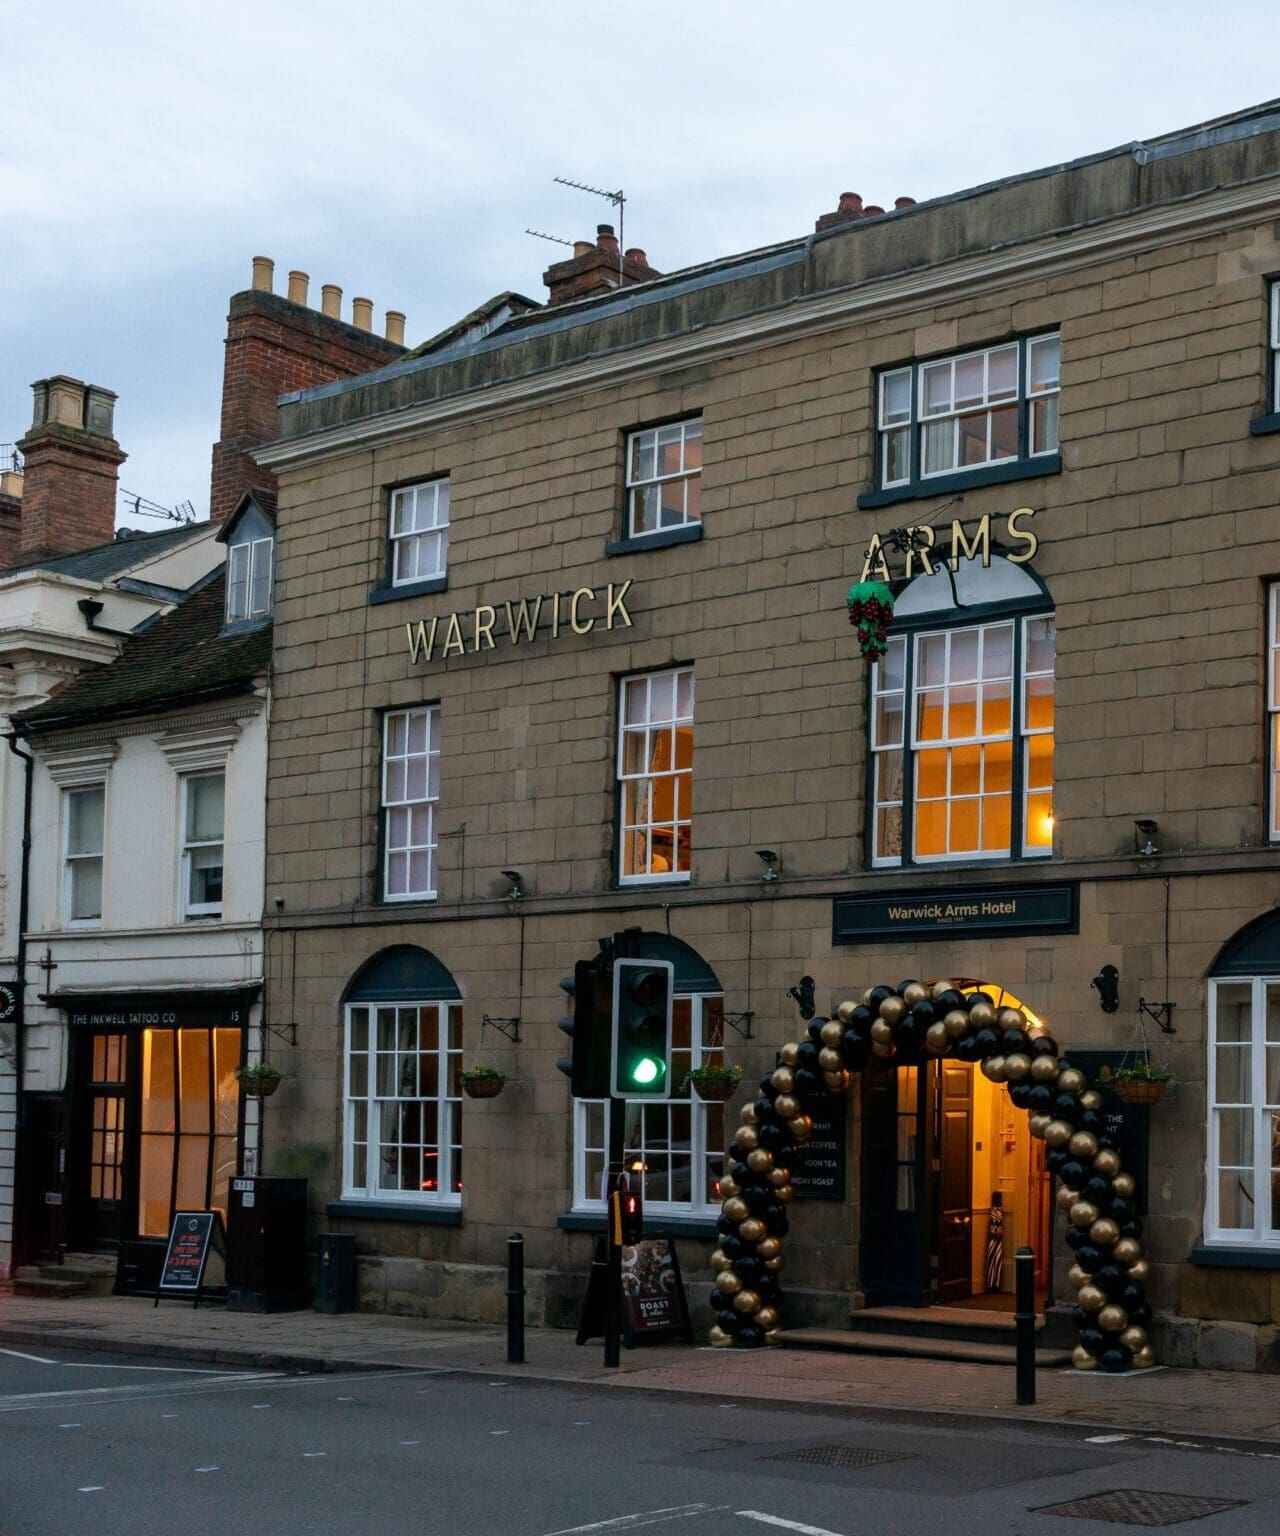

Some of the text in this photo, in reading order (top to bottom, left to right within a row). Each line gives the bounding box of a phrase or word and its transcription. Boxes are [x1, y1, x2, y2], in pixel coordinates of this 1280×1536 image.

[859, 506, 1041, 584] ARMS
[405, 578, 634, 666] WARWICK
[888, 904, 942, 920] Warwick
[945, 903, 979, 917] Arms
[981, 900, 1016, 915] Hotel
[72, 1014, 88, 1024] THE
[90, 1014, 126, 1024] INKWELL
[128, 1012, 159, 1024] TATTOO
[231, 1010, 240, 1022] 15
[824, 1159, 837, 1168] TEA
[812, 1177, 834, 1186] ROAST
[640, 1300, 669, 1310] ROAST
